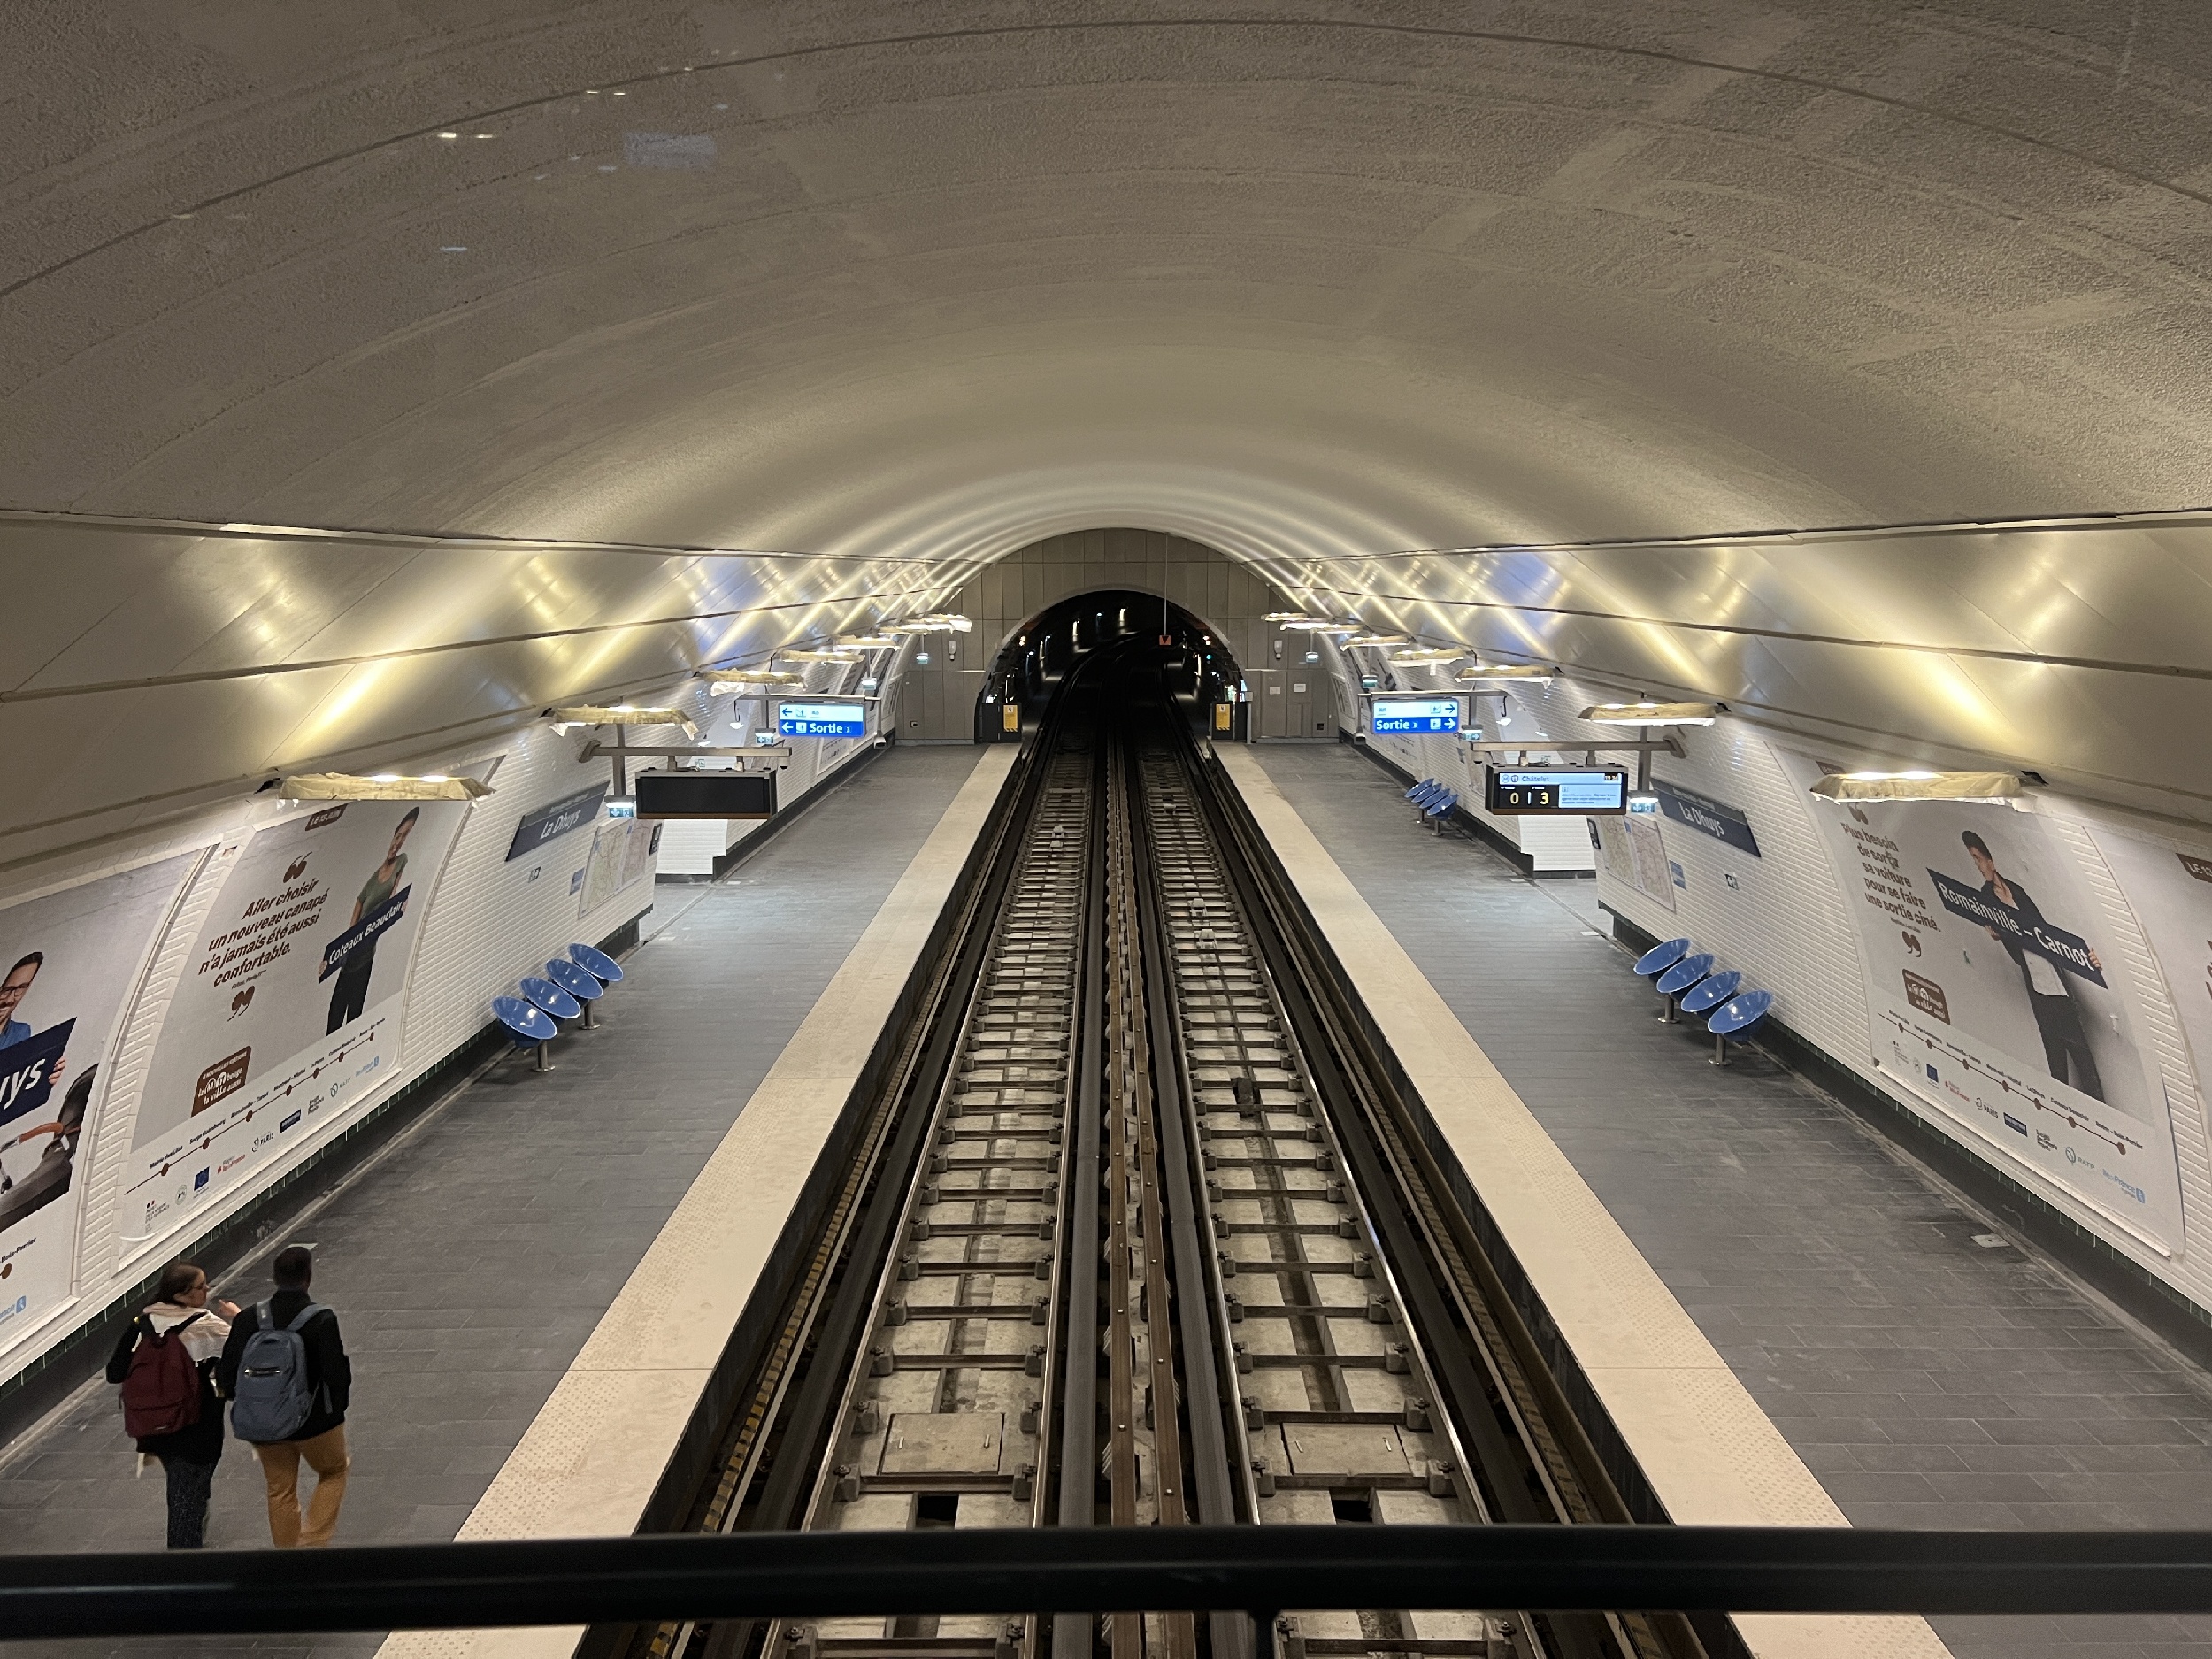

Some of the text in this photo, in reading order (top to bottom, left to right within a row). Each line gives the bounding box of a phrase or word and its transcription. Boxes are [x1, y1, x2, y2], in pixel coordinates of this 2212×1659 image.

[810, 723, 843, 733] Sortie
[1376, 718, 1410, 730] Sortie
[1510, 792, 1519, 804] 0
[1540, 792, 1549, 804] 3
[540, 810, 581, 840] La Dhuys
[1678, 801, 1724, 837] La Dhuys
[1841, 822, 1899, 852] Plus besoin
[1857, 843, 1870, 858] de
[1862, 862, 1912, 888] sa voiture
[2185, 861, 2202, 874] LE
[242, 878, 319, 920] Aller choisir
[1863, 877, 1926, 910] pour se faire
[209, 887, 330, 952] un nouveau canapé
[1865, 892, 1883, 909] une
[1883, 899, 1914, 921] sortie
[1915, 910, 1941, 933] ciné.
[1938, 880, 2023, 937] Romainville
[2034, 926, 2095, 972] Carnot
[219, 933, 266, 970] jamais
[266, 922, 290, 945] été
[288, 908, 322, 935] aussi
[329, 901, 403, 964] Coteaux Beauclair
[214, 941, 291, 987] confortable.
[260, 1131, 274, 1145] PARIS
